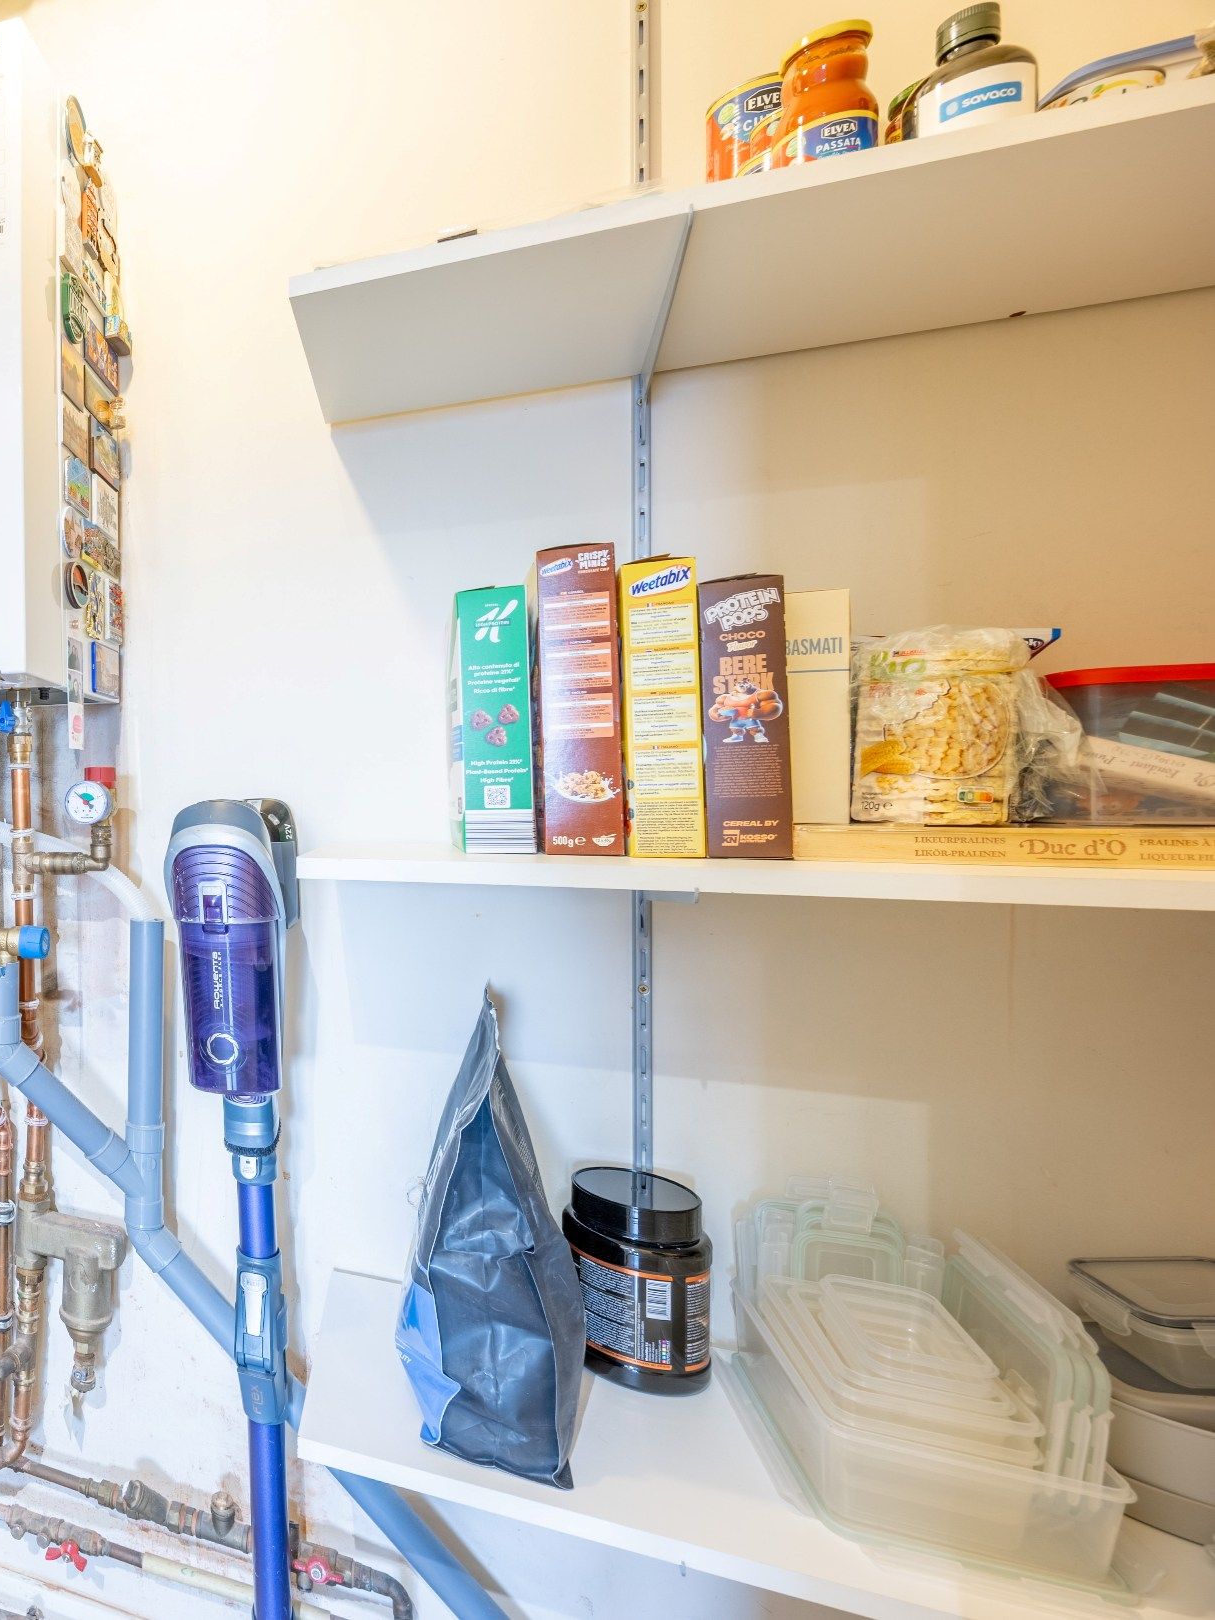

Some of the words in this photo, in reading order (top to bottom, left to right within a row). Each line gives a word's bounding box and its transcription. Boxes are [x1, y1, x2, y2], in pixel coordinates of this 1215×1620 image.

[747, 92, 781, 111] ELVE
[823, 121, 856, 136] ELVEA
[815, 138, 861, 154] PASSATA
[577, 550, 610, 560] CRISPY
[631, 566, 692, 596] Weetabix
[704, 588, 781, 625] PROTEIN
[720, 605, 769, 632] POPS
[719, 630, 766, 642] CHOCO
[726, 640, 758, 653] Flavor
[719, 654, 768, 676] BERE
[861, 800, 880, 811] 120g
[283, 823, 293, 840] 22V
[552, 835, 574, 847] 500g
[914, 836, 1006, 845] LIKEURPRALINES
[1019, 838, 1076, 856] Duc
[1139, 838, 1199, 847] PRALINES
[914, 848, 1007, 858] LIKÖR-PRALINEN
[1140, 852, 1195, 862] LIQUEUR
